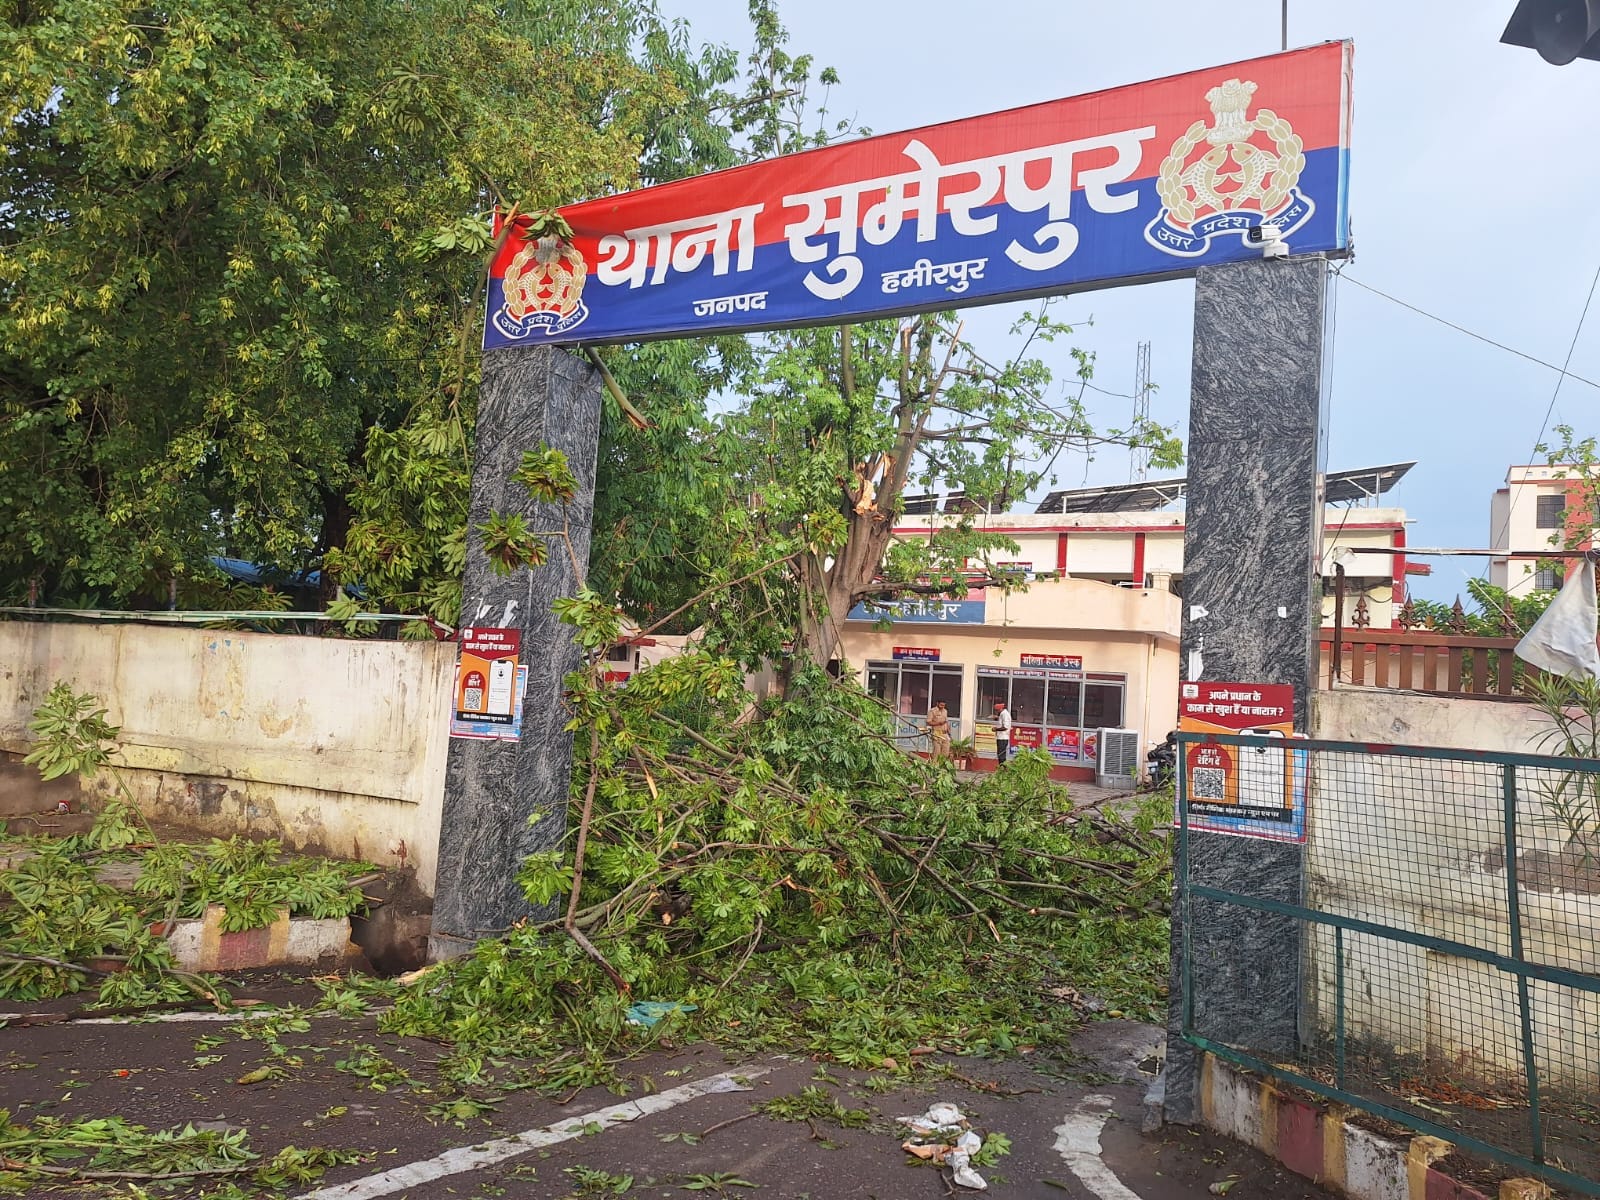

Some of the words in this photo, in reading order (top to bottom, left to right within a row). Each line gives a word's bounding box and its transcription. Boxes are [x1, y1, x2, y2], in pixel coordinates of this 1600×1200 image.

[597, 202, 764, 290] थाना
[783, 125, 1156, 301] सुमेरपुर
[1156, 226, 1195, 250] उत्तर
[1202, 214, 1251, 234] प्रदेश
[692, 291, 769, 317] जनपद
[881, 257, 989, 294] हमीरपुर
[1022, 654, 1045, 666] महिला
[1208, 689, 1229, 700] अपने
[1229, 691, 1252, 701] प्रधान
[1252, 690, 1262, 702] के
[1186, 703, 1204, 712] काम
[1205, 702, 1214, 713] से
[1214, 704, 1232, 717] खुश
[1241, 705, 1250, 715] या
